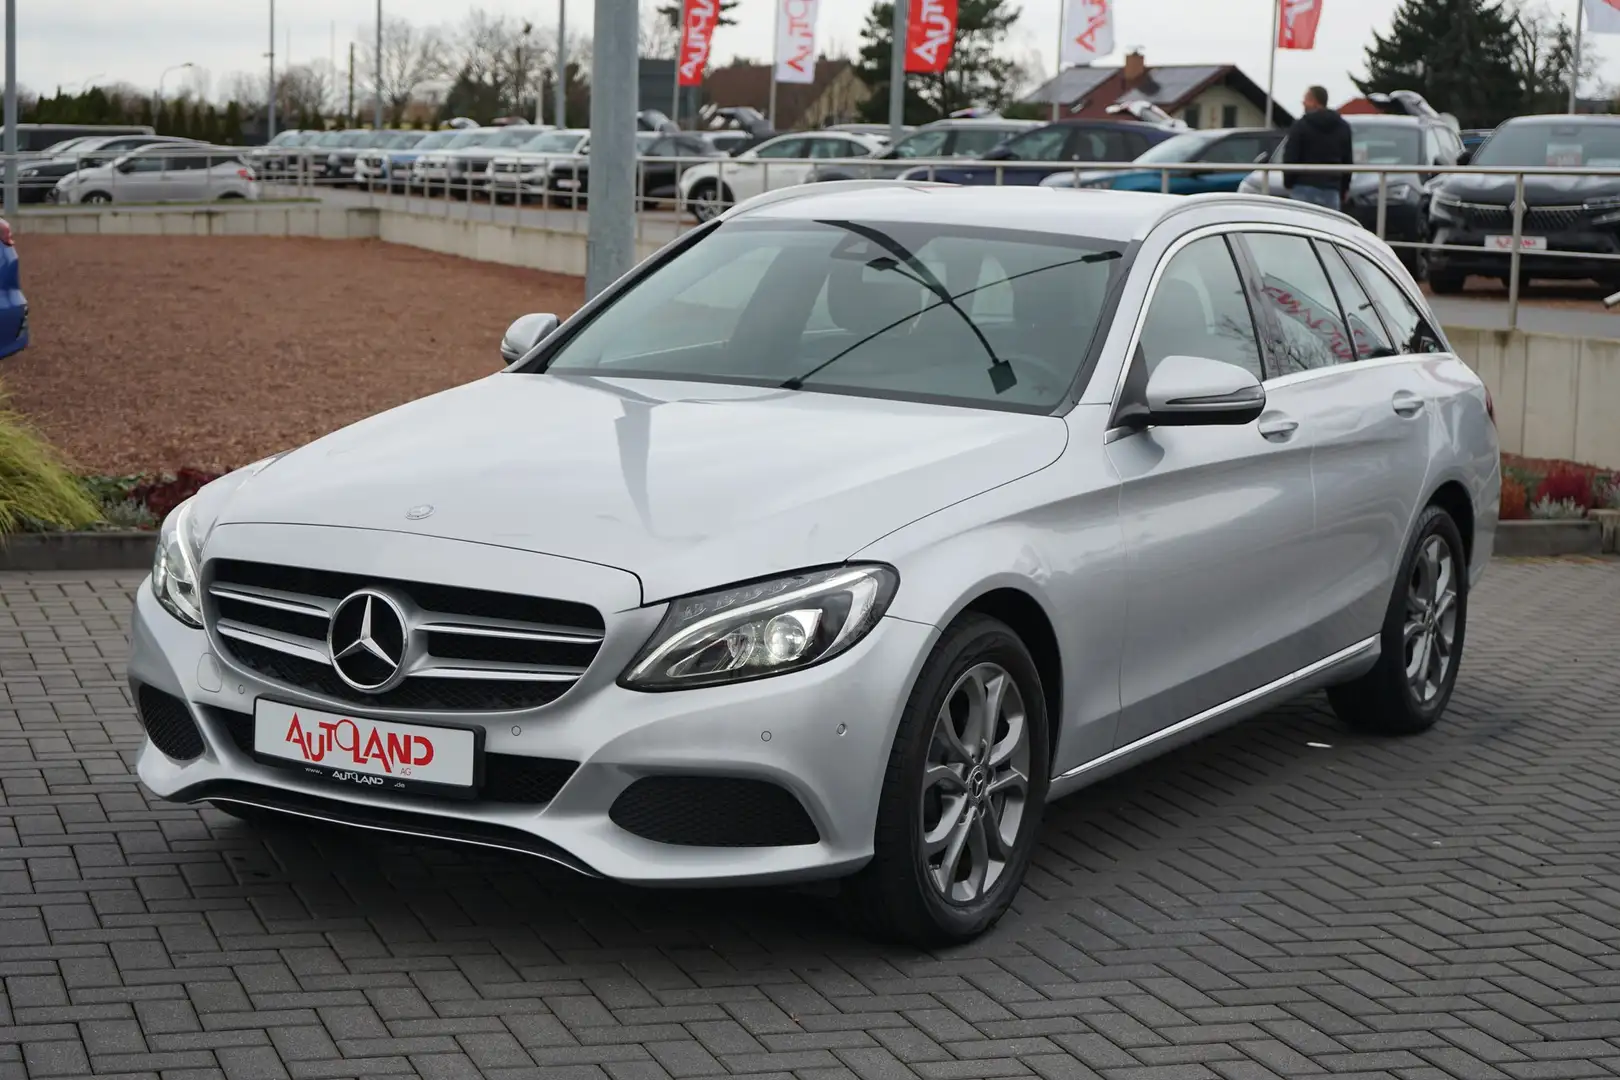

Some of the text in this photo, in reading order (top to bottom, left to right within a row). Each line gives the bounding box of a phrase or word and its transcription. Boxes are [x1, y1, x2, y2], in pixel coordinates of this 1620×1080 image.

[785, 0, 815, 73] AUTO
[913, 0, 951, 65] AUT
[1076, 0, 1107, 53] AU
[285, 712, 434, 773] AUTOLAND
[304, 767, 323, 775] www.
[332, 770, 384, 785] AUTOLAND
[400, 767, 412, 776] AG
